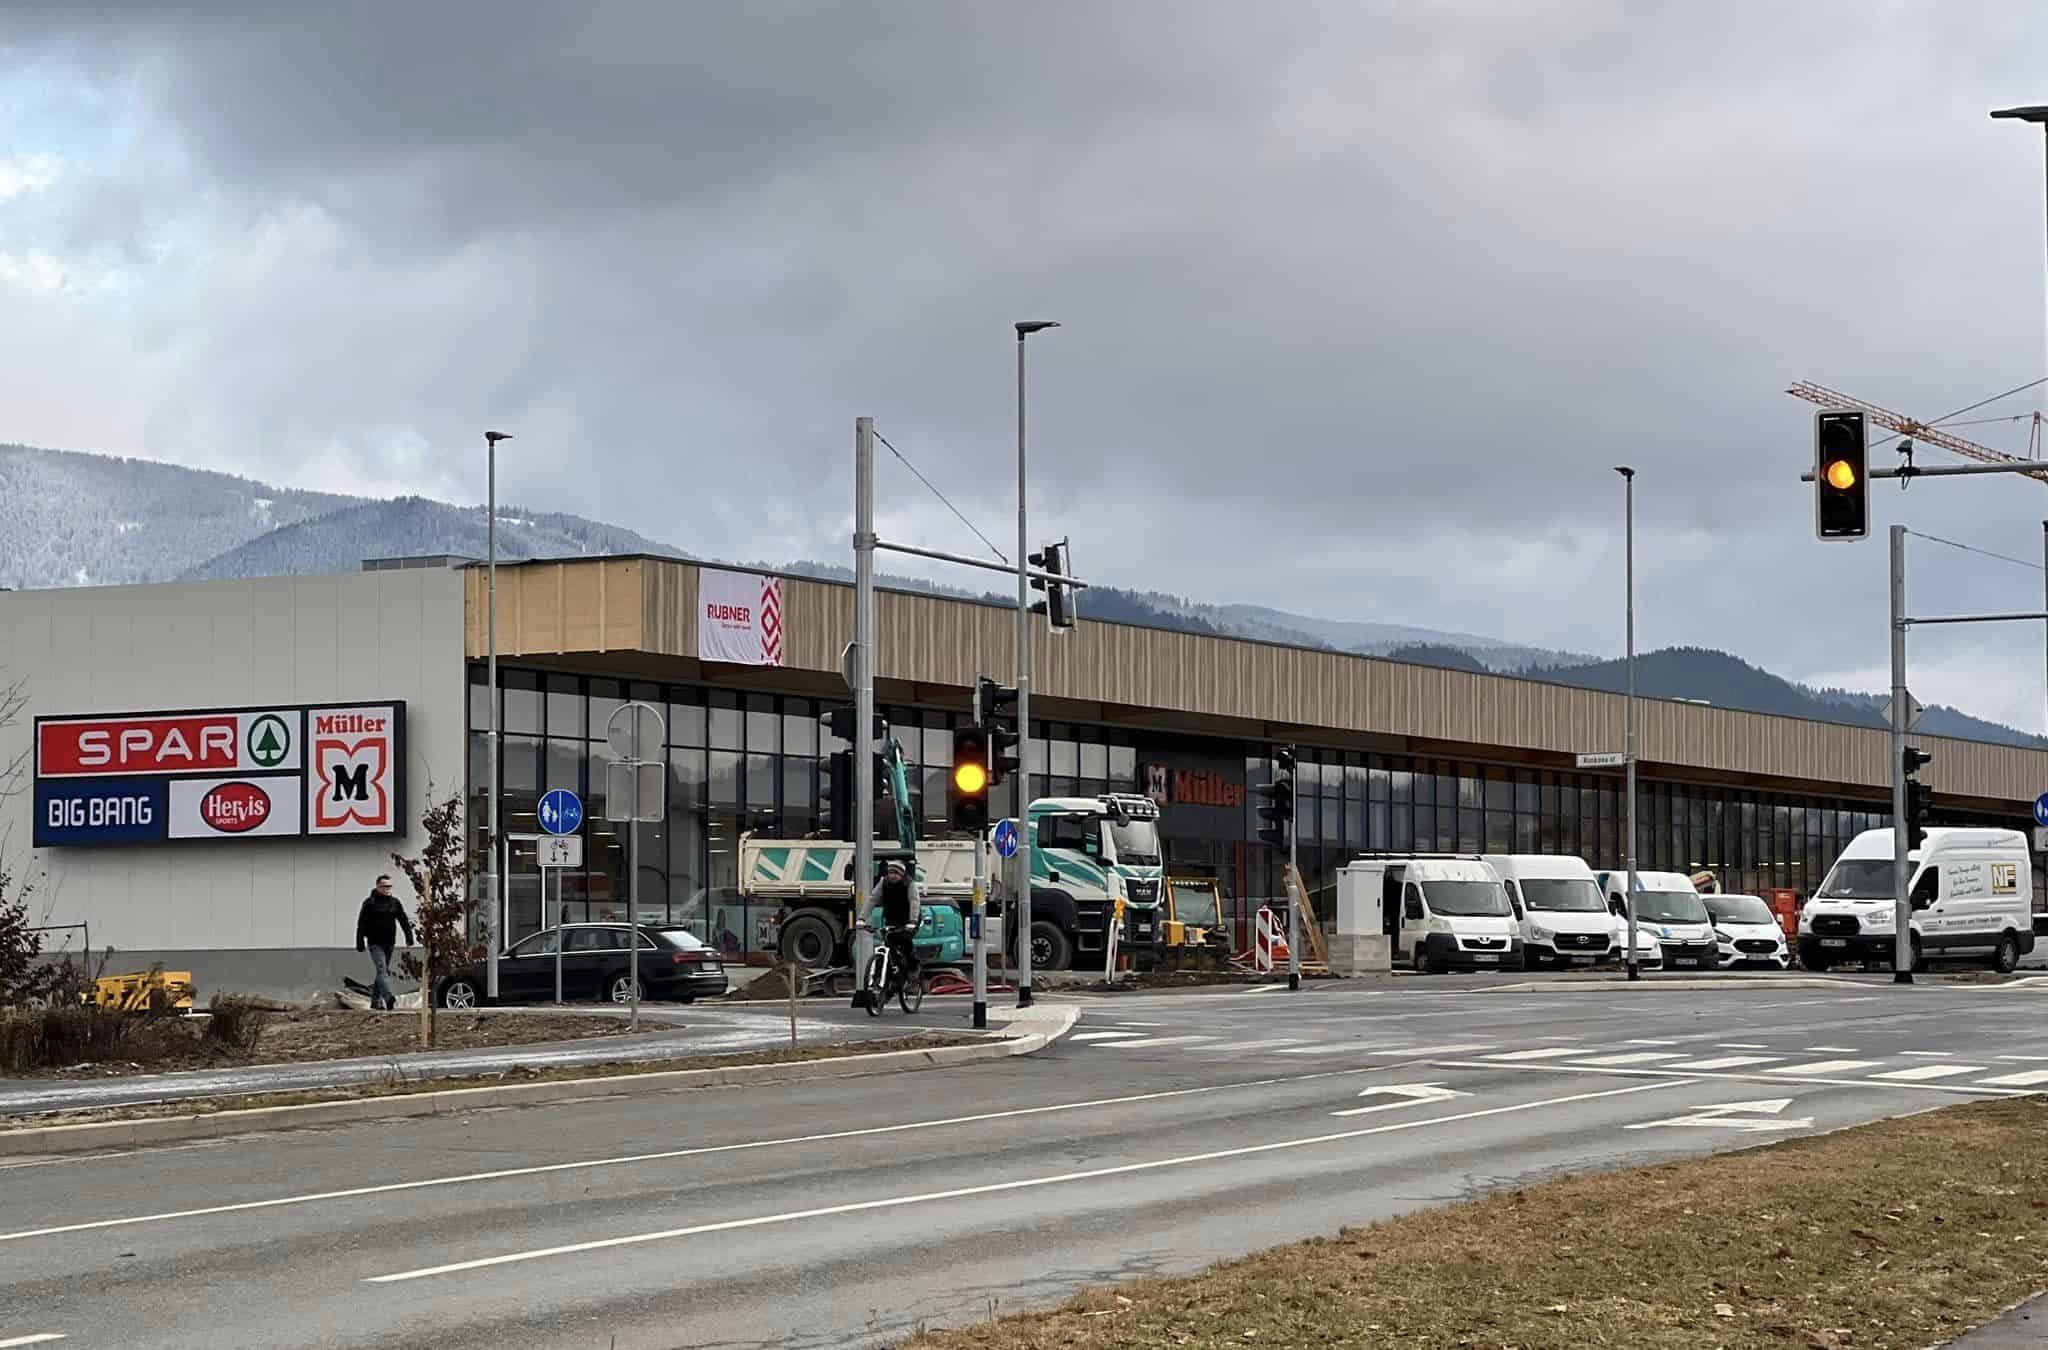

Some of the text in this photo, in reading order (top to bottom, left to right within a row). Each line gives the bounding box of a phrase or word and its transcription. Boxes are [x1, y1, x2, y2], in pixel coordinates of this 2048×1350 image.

[707, 604, 750, 622] RUBNER
[315, 715, 386, 735] Müller
[78, 726, 234, 765] SPAR
[332, 764, 369, 802] M
[1176, 769, 1246, 807] Müller
[49, 796, 152, 827] BIG BANG
[208, 795, 265, 818] Hervis
